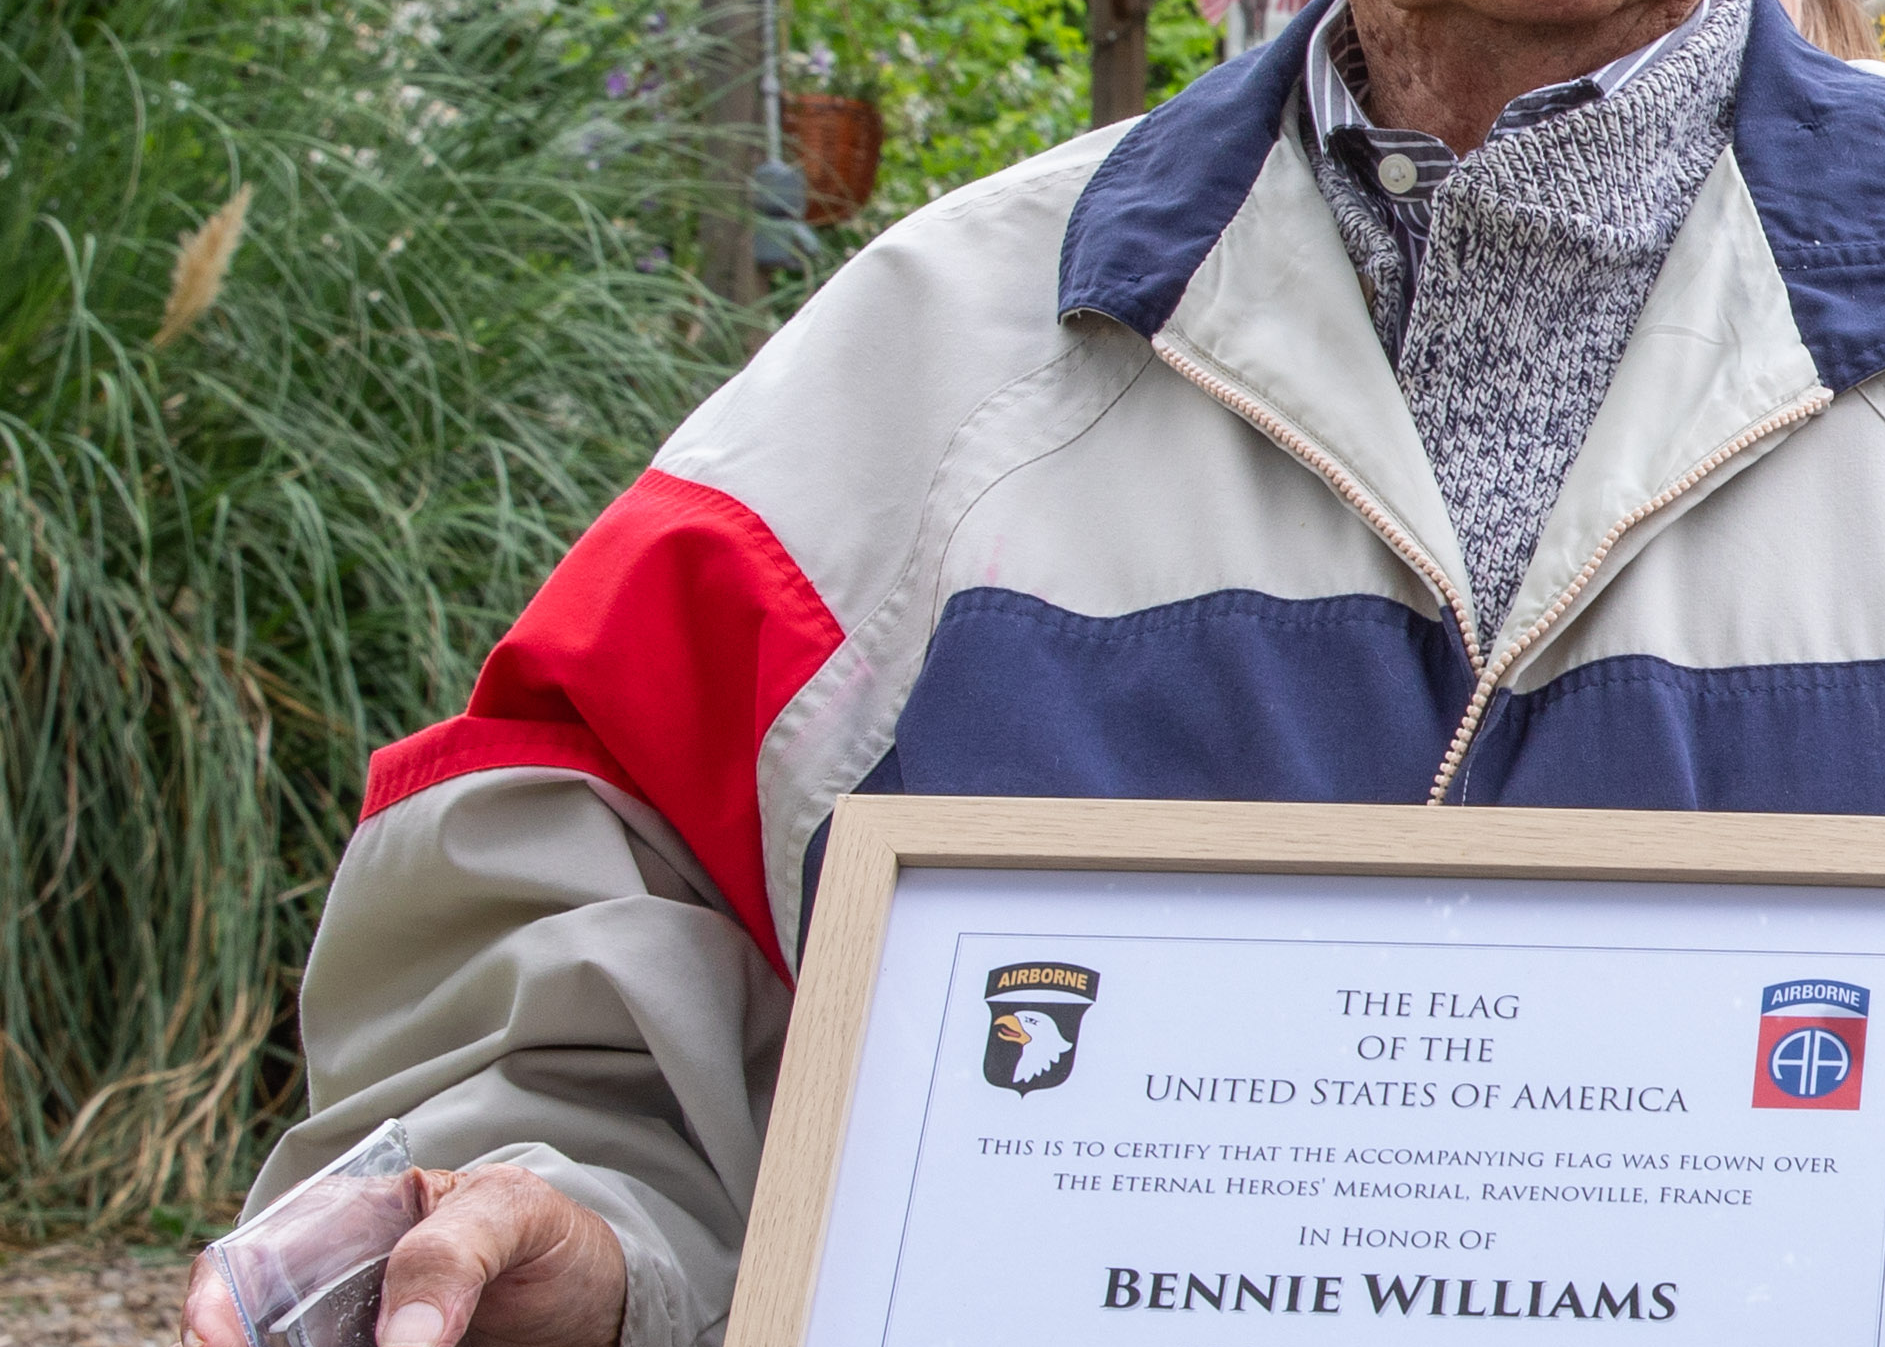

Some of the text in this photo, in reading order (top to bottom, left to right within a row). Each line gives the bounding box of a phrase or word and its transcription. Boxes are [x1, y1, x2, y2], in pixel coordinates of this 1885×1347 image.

[998, 967, 1088, 992] AIRBORNE
[1337, 989, 1519, 1020] THE FLAG
[1770, 984, 1861, 1008] AIRBORNE
[1357, 1035, 1494, 1063] OF THE
[1146, 1074, 1688, 1113] UNITED STATES OF AMERICA
[977, 1137, 1838, 1174] THIS IS TO CERTIFY THAT THE ACCOMPANYING FLAG WAS FLOWN OVER
[1053, 1173, 1752, 1206] THE ETERNAL HEROES' MEMORIAL, RAVENOVILLE, FRANCE
[1299, 1226, 1497, 1250] IN HONOR OF
[1100, 1267, 1679, 1321] BENNIE WILLIAMS
